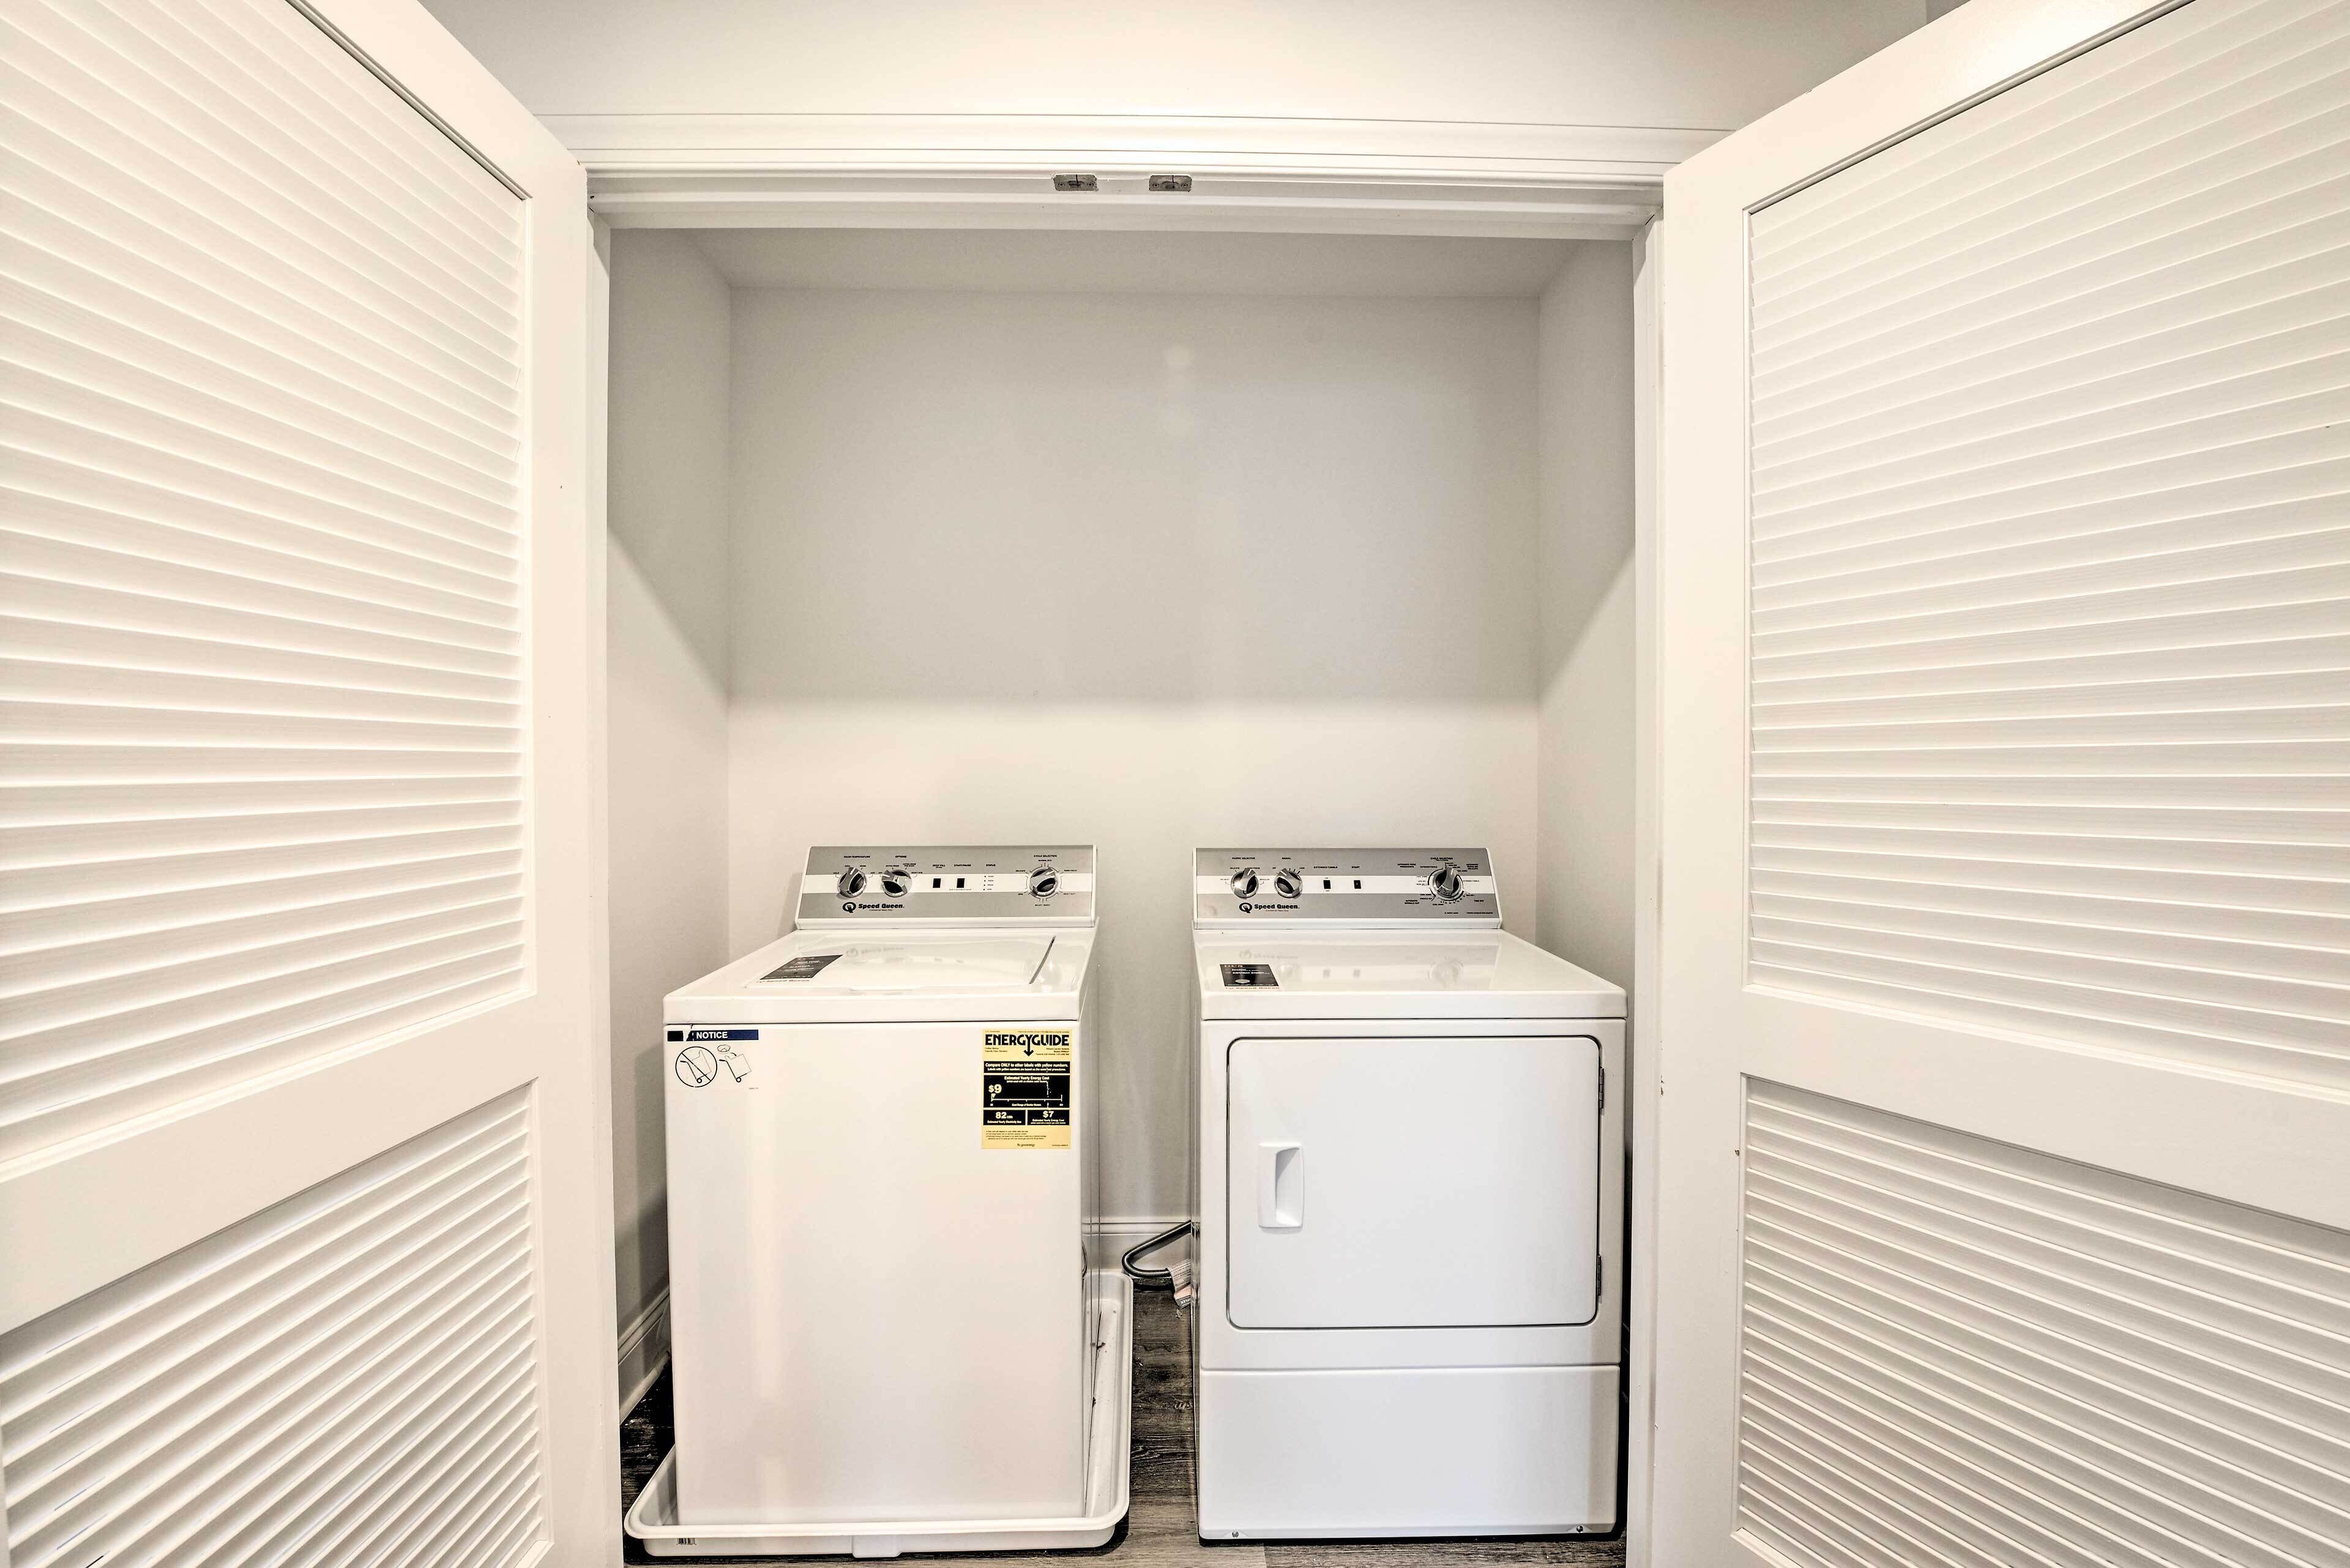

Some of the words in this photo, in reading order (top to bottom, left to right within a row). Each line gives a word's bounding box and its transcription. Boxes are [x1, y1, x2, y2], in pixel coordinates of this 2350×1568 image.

[985, 1034, 1069, 1046] ENERGYGUIDE
[988, 1084, 1002, 1094] $9
[1043, 1110, 1054, 1119] $7
